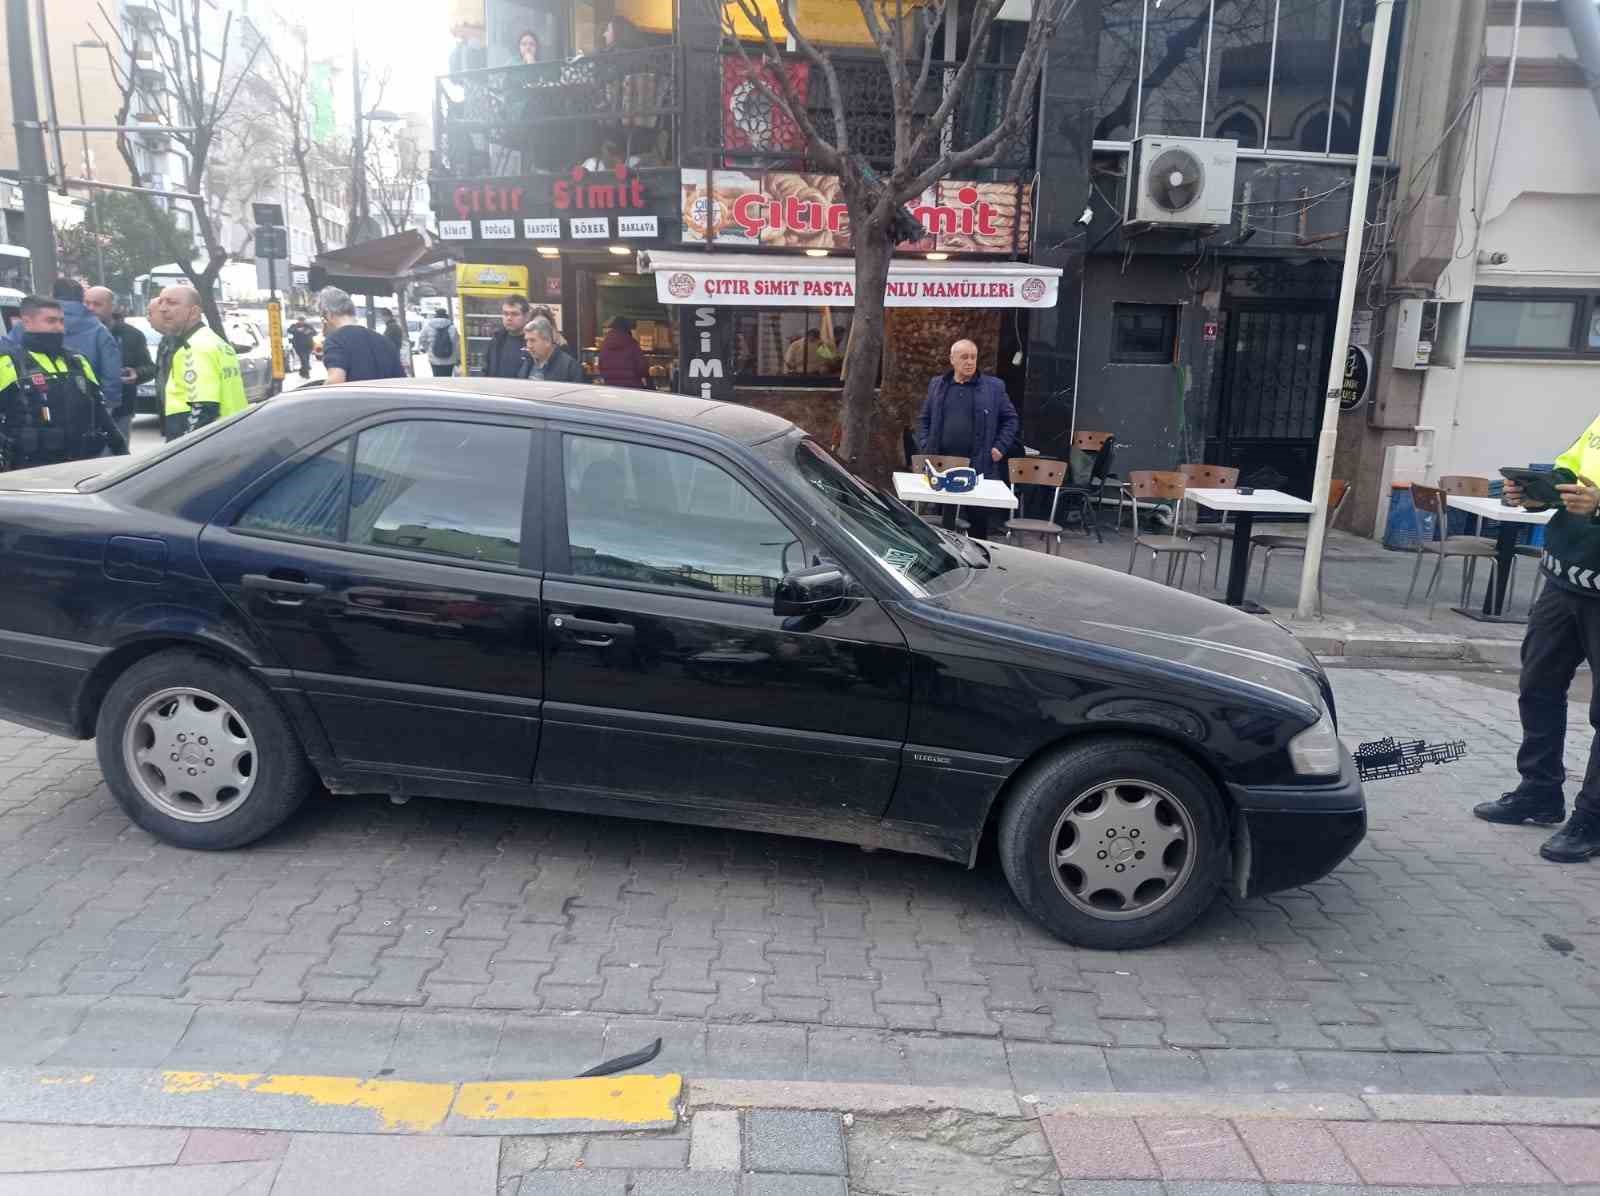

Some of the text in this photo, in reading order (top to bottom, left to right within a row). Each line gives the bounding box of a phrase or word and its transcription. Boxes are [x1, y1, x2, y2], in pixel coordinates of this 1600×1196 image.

[554, 163, 645, 209] Simit
[733, 192, 849, 238] Çıtır
[574, 221, 606, 234] BÖREK
[620, 222, 656, 233] BAKLAVA
[886, 282, 918, 297] NLU
